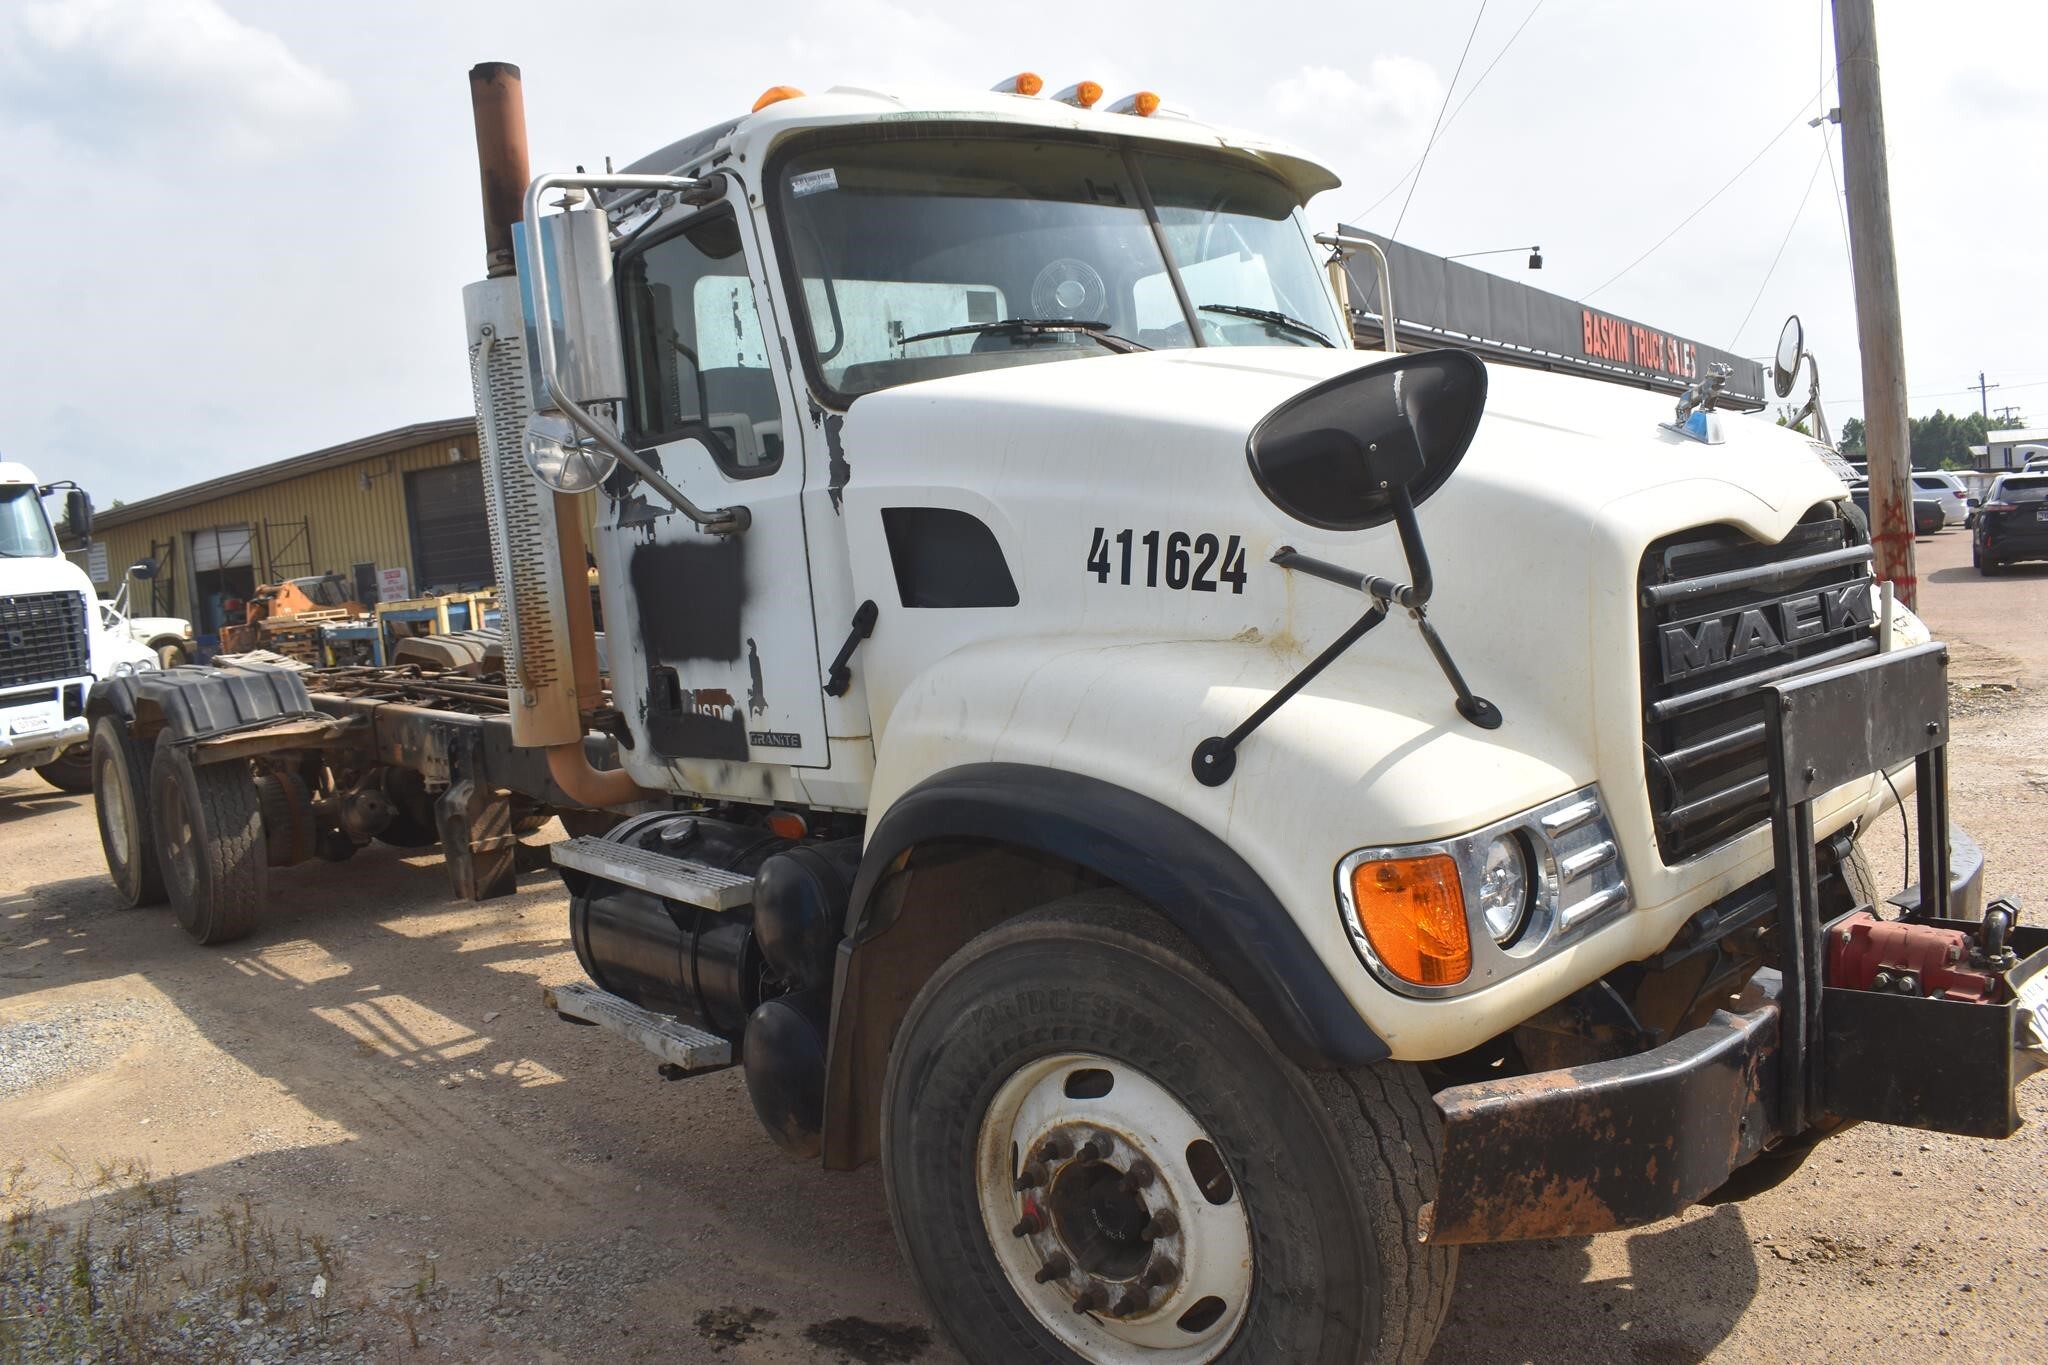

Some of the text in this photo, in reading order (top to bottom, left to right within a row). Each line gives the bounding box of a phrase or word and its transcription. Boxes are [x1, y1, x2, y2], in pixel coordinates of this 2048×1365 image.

[1582, 309, 1629, 363] BASKIN
[1666, 335, 1697, 380] SALES
[1087, 527, 1247, 595] 411624
[1662, 583, 1873, 680] MACK
[750, 733, 799, 747] GRANITE
